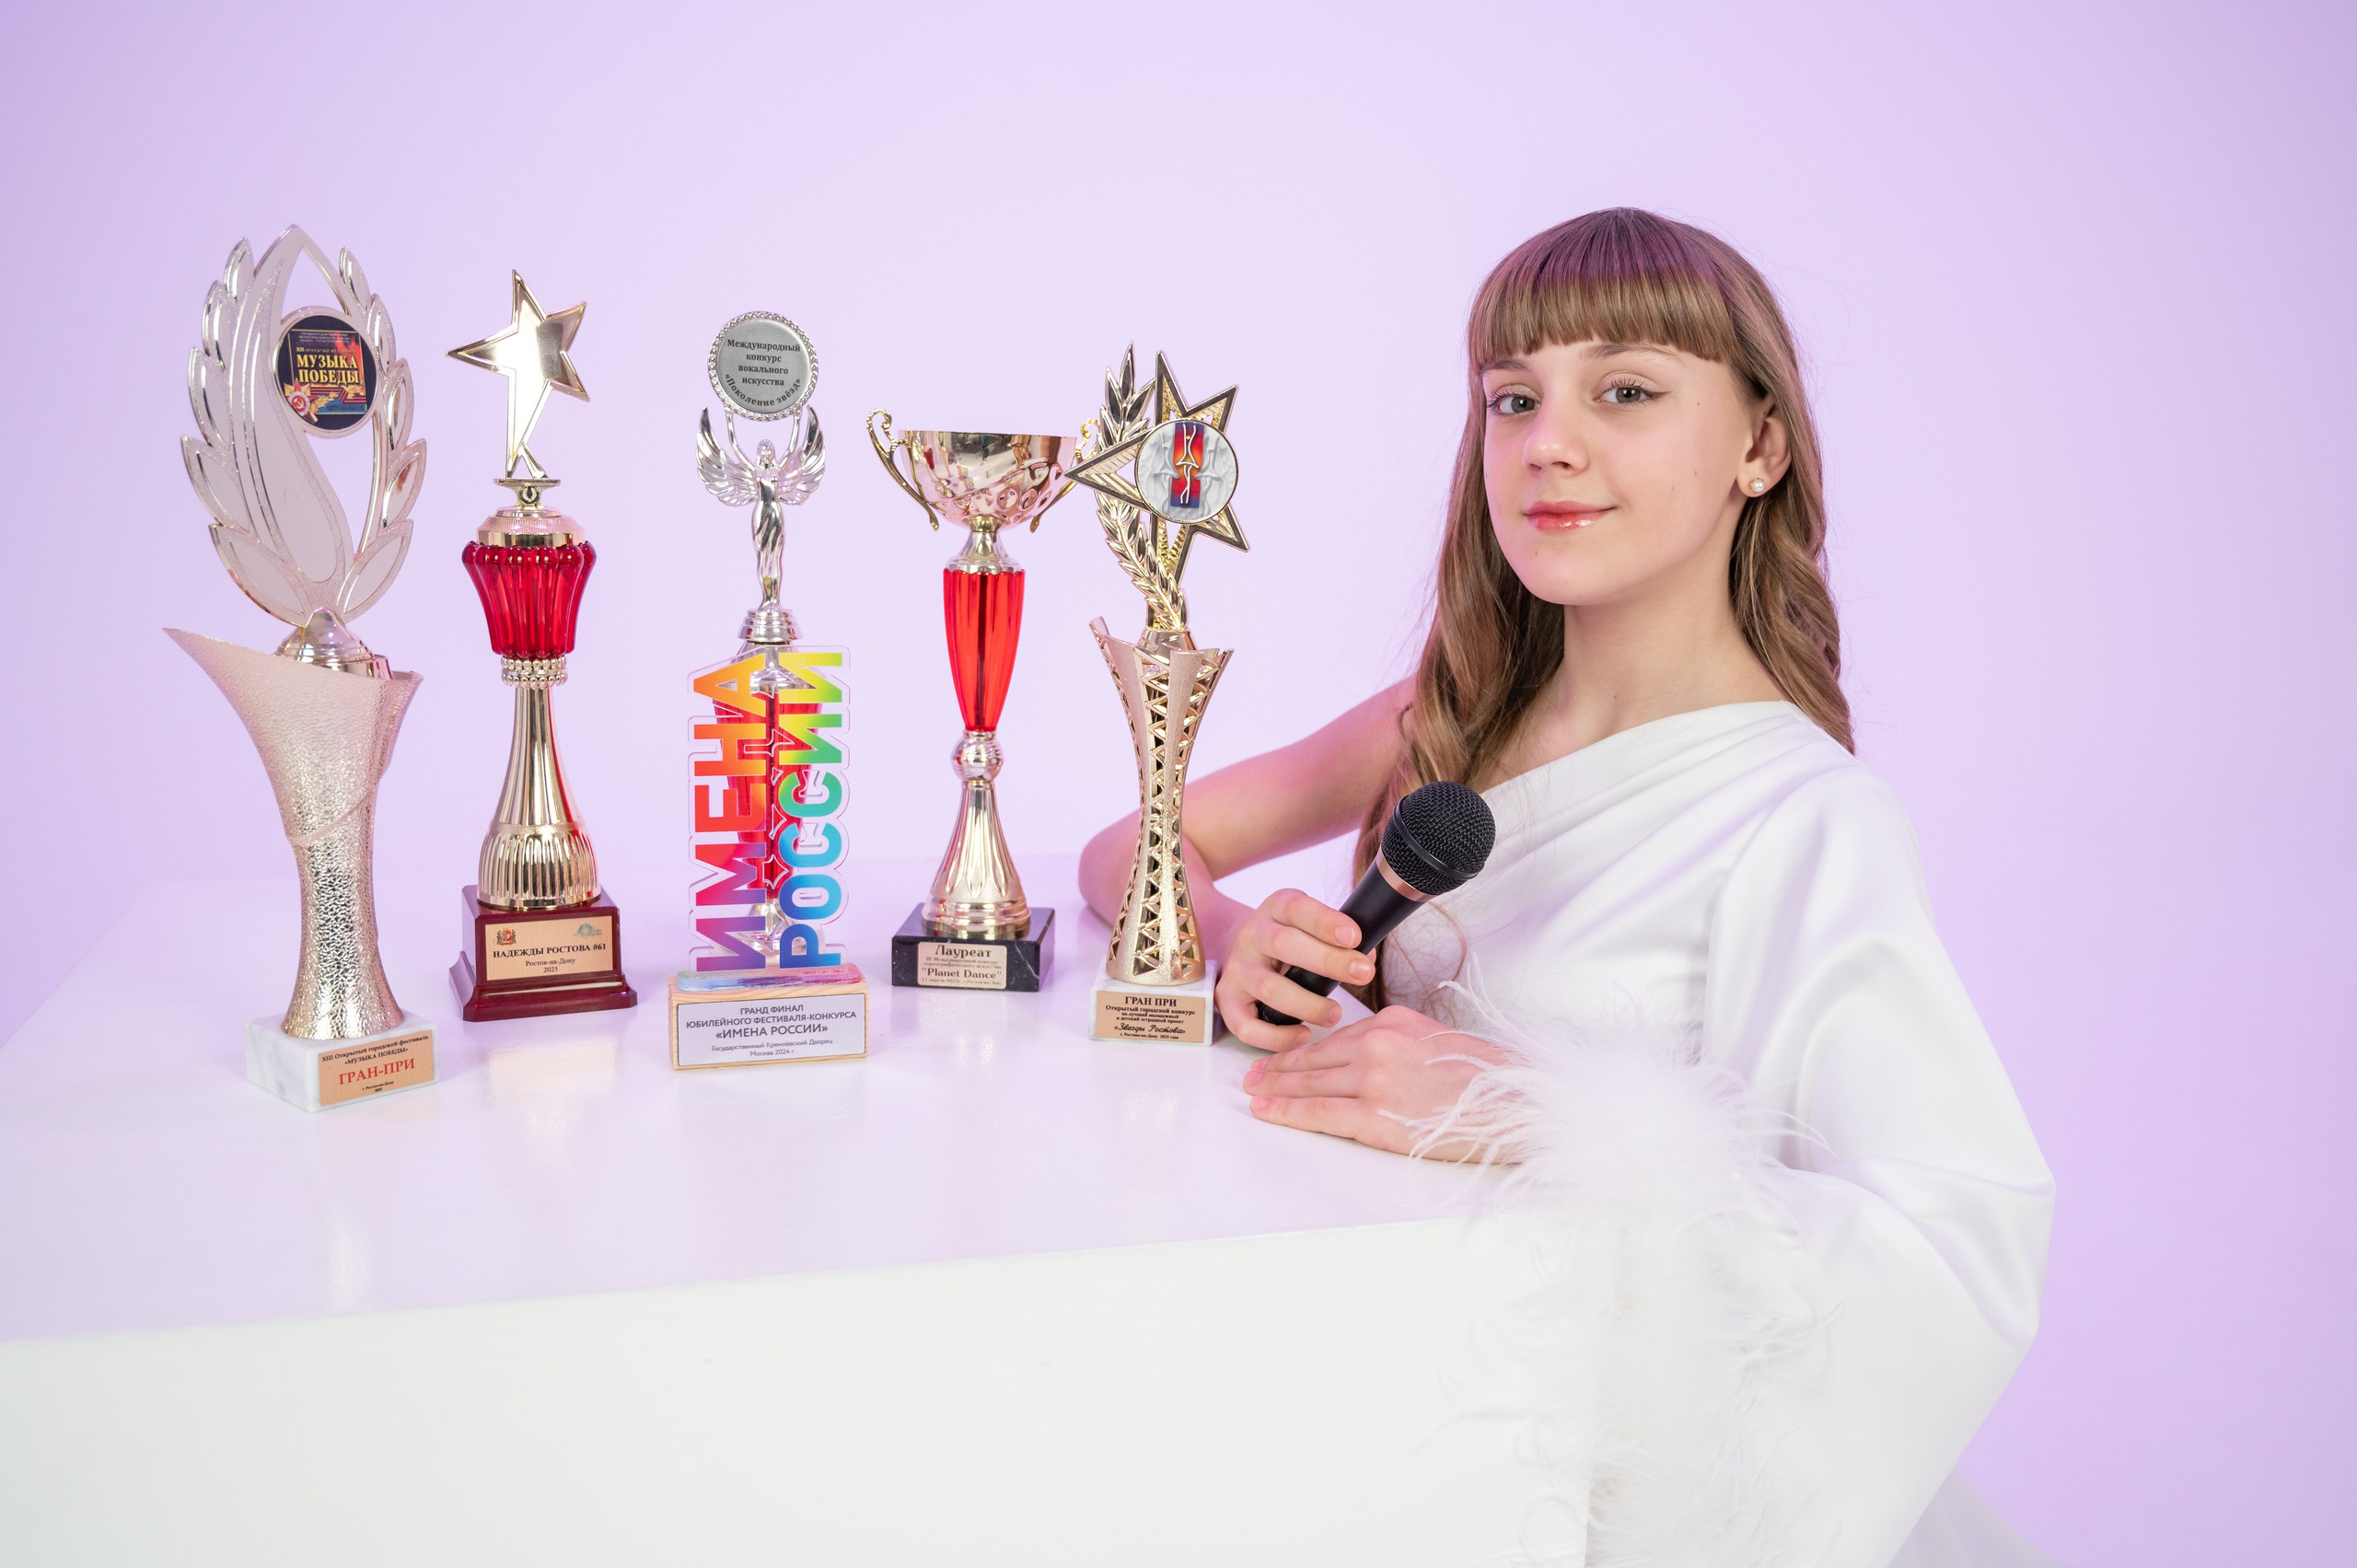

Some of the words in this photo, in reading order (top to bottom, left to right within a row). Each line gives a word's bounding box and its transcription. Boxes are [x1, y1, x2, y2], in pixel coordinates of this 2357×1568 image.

[726, 339, 801, 352] Международный
[297, 355, 357, 367] МУЗЫКА
[746, 354, 782, 364] конкурс
[738, 365, 789, 375] вокального
[299, 370, 358, 385] ПОБЕДЫ
[742, 377, 784, 386] искусства
[725, 374, 775, 406] «Поколение
[777, 378, 801, 403] звёзд»
[692, 653, 767, 972] ИМЕНА
[778, 652, 842, 969] РОССИИ
[493, 948, 544, 958] НАДЕЖДЫ
[546, 945, 591, 955] РОСТОВА
[593, 943, 607, 951] #61
[935, 944, 993, 958] Лауреат
[525, 958, 576, 967] Ростов-на-Дону
[922, 967, 959, 977] "Planet
[964, 970, 1002, 979] Dance"
[1124, 996, 1152, 1005] ГРАН
[1155, 998, 1177, 1007] ПРИ
[740, 1006, 769, 1016] ГРАНД
[771, 1005, 804, 1014] ФИНАЛ
[686, 1016, 752, 1028] ЮБИЛЕЙНОГО
[753, 1011, 857, 1025] ФЕСТИВАЛЯ-КОНКУРСА
[715, 1026, 768, 1039] «ИМЕНА
[771, 1024, 829, 1036] РОССИИ»
[1114, 1023, 1145, 1033] «Звезды
[1148, 1025, 1186, 1034] Ростова»
[322, 1054, 333, 1063] XIII
[334, 1048, 367, 1060] Открытый
[368, 1041, 398, 1052] городской
[399, 1035, 429, 1046] фестиваль
[712, 1042, 765, 1051] Государственный
[766, 1039, 808, 1048] Кремлёвский
[809, 1038, 833, 1047] Дворец
[344, 1054, 377, 1065] «МУЗЫКА
[377, 1047, 409, 1058] ПОБЕДЫ»
[339, 1058, 415, 1086] ГРАН-ПРИ
